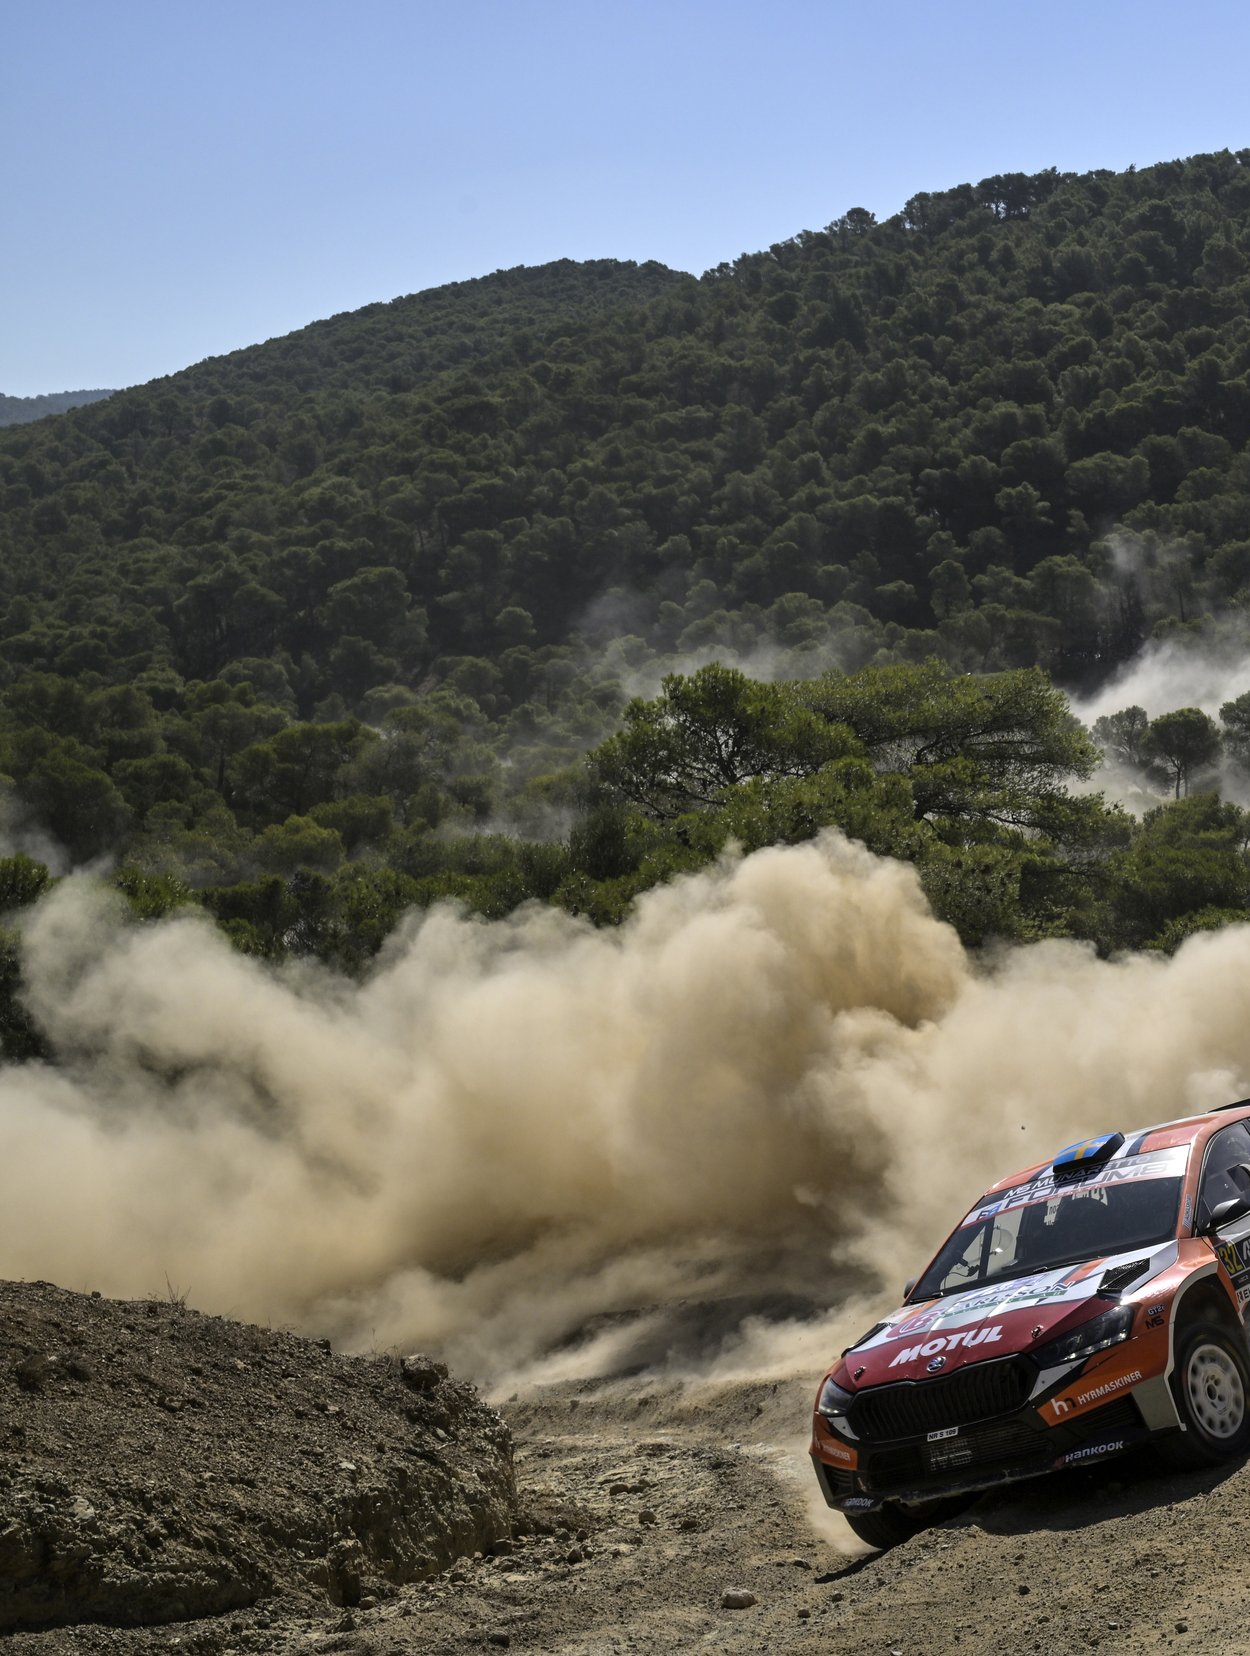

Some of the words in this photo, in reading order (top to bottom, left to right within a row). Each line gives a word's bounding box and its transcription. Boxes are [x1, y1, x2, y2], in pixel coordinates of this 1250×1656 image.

[1005, 1162, 1168, 1208] FORUM8
[1219, 1243, 1244, 1274] 32
[889, 1326, 1003, 1368] MOTUL
[1077, 1371, 1142, 1405] HYRMASKINER
